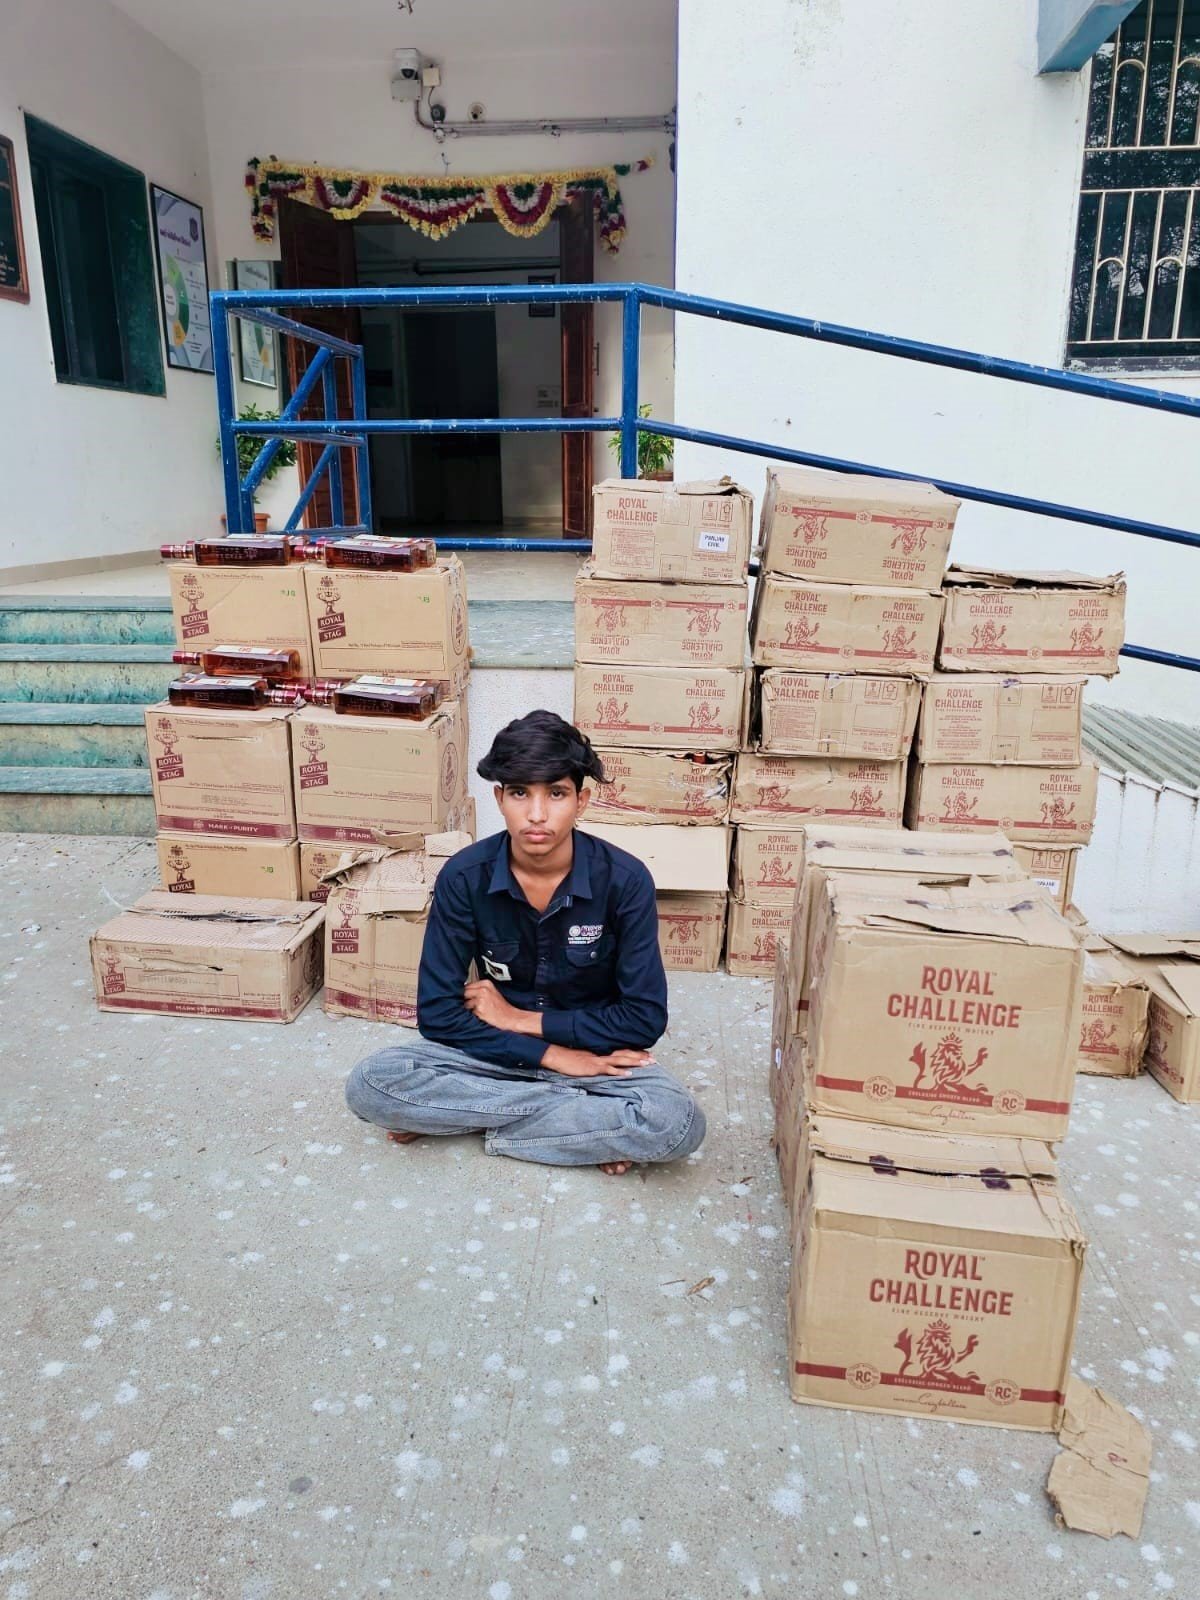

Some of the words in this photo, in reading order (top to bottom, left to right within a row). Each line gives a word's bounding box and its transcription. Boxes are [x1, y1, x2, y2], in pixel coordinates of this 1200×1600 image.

[619, 498, 648, 509] ROYAL
[607, 510, 658, 522] CHALLENGE
[785, 547, 827, 559] CHALLENGE
[792, 559, 816, 569] ROYAL
[882, 559, 926, 572] CHALLENGE
[889, 570, 914, 581] ROYAL
[795, 591, 820, 602] ROYAL
[981, 595, 1005, 604] ROYAL
[784, 601, 828, 612] CHALLENGE
[894, 602, 918, 612] ROYAL
[1079, 599, 1102, 608] ROYAL
[970, 605, 1013, 614] CHALLENGE
[1069, 608, 1109, 617] CHALLENGE
[183, 613, 206, 624] ROYAL
[320, 615, 343, 627] ROYAL
[882, 611, 925, 622] CHALLENGE
[187, 627, 205, 636] STAG
[323, 630, 342, 640] STAG
[602, 674, 625, 683] ROYAL
[781, 677, 809, 687] ROYAL
[593, 684, 634, 693] CHALLENGE
[696, 680, 718, 689] ROYAL
[686, 689, 726, 698] CHALLENGE
[774, 687, 820, 700] HALLENGE
[947, 689, 973, 698] ROYAL
[935, 699, 983, 709] CHALLENGE
[158, 756, 181, 766] ROYAL
[764, 760, 788, 768] ROYAL
[302, 765, 326, 774] ROYAL
[858, 764, 881, 772] ROYAL
[952, 768, 977, 777] ROYAL
[162, 770, 180, 779] STAG
[848, 771, 889, 781] CHALLENGE
[1050, 774, 1073, 783] ROYAL
[305, 778, 324, 787] STAG
[942, 777, 984, 787] CHALLENGE
[1040, 784, 1081, 793] CHALLENGE
[758, 844, 799, 852] CHALLENGE
[171, 883, 193, 892] ROYAL
[312, 891, 329, 899] ROYA
[761, 910, 784, 918] ROYAL
[921, 965, 995, 996] ROYAL
[1088, 995, 1113, 1003] ROYAL
[887, 993, 1022, 1028] CHALLENGE
[1082, 1004, 1125, 1014] HALLENGE
[872, 1083, 888, 1097] RC
[1002, 1098, 1017, 1110] RC
[904, 1249, 983, 1281] ROYAL
[869, 1278, 1014, 1316] CHALLENGE
[855, 1371, 871, 1383] RC
[994, 1386, 1012, 1399] RC
